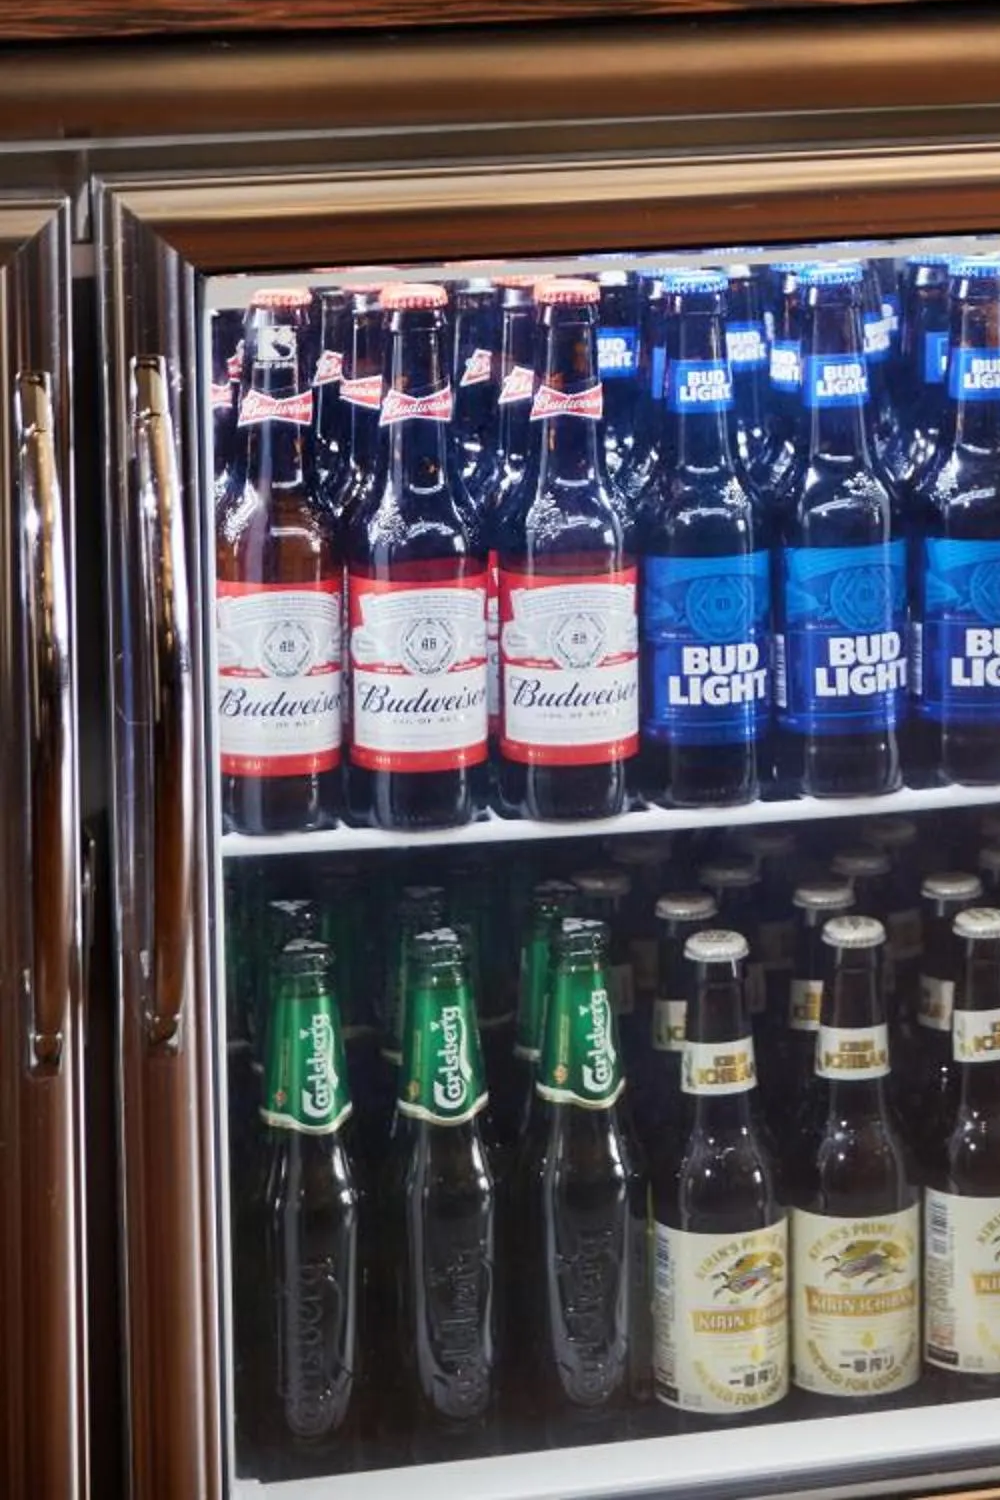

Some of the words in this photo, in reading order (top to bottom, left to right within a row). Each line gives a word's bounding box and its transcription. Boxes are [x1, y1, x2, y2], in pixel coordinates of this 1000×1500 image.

[688, 369, 725, 387] BUD
[816, 377, 868, 397] LIGHT
[823, 363, 861, 380] BUD
[679, 384, 732, 402] LIGHT
[682, 642, 760, 675] BUD
[828, 631, 901, 667] BUD
[669, 668, 767, 705] LIGHT
[815, 657, 908, 697] LIGHT
[433, 1005, 473, 1110] Carlsberg
[582, 989, 617, 1093] Carlsberg
[302, 1013, 339, 1118] Carlsberg
